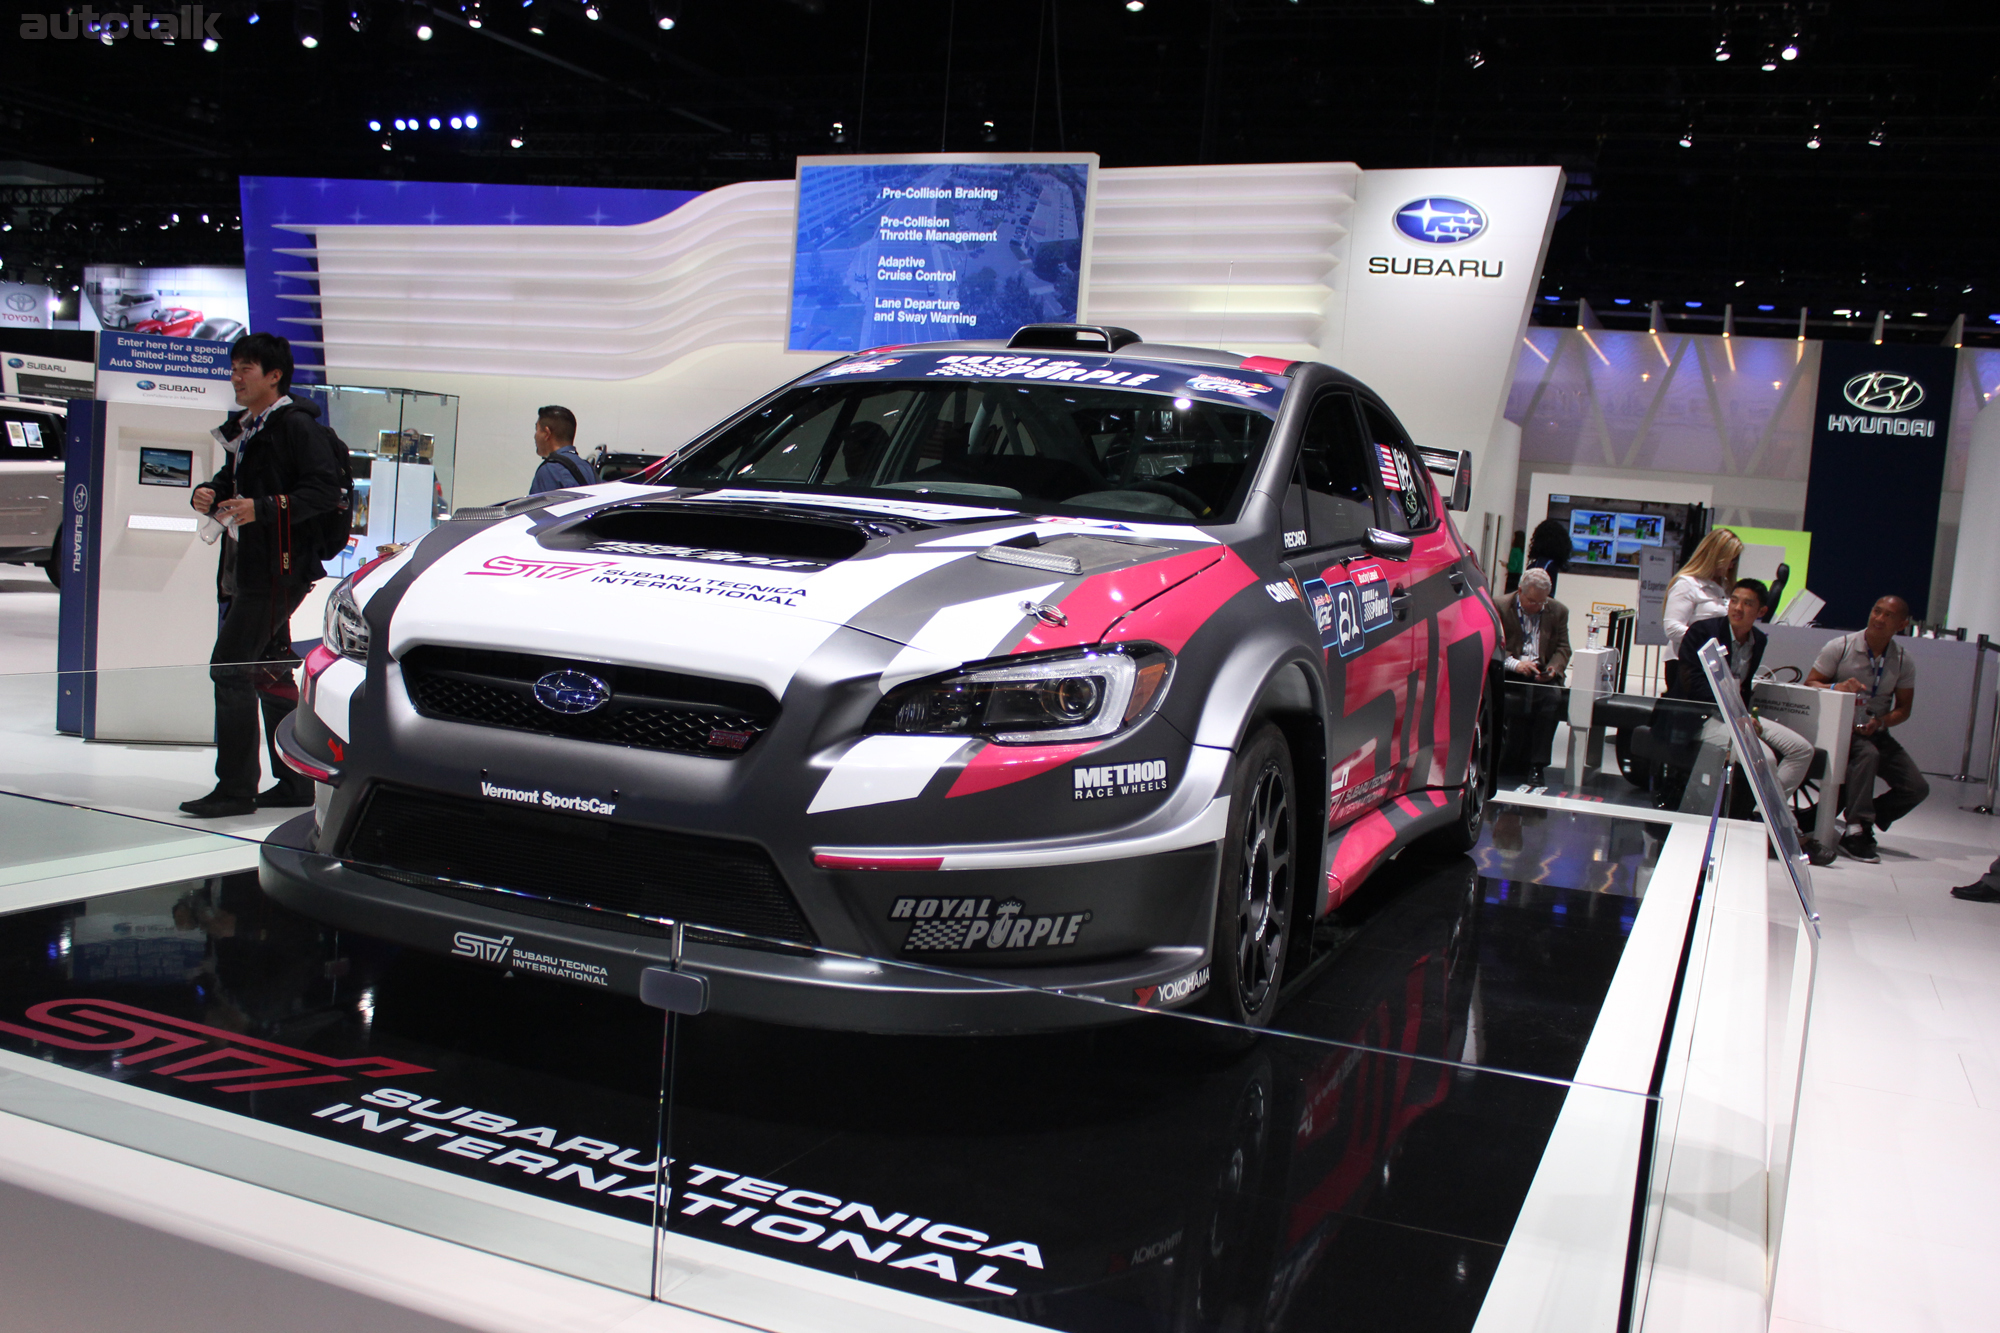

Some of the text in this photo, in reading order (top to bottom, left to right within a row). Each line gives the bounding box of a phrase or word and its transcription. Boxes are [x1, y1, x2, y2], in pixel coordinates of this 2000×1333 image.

[882, 187, 998, 201] Pre-Collision Braking
[880, 215, 950, 228] Pre-Collision
[880, 229, 998, 243] Throttle Management
[877, 255, 925, 269] Adaptive
[1368, 256, 1504, 278] SUBARU
[877, 268, 956, 282] Cruise Control
[874, 297, 960, 311] Lane Departure
[2, 313, 40, 323] TOYOTA
[873, 311, 977, 327] and Sway Warning
[117, 337, 229, 356] Enter here for a special
[130, 348, 214, 365] limited-time $250
[26, 361, 67, 373] SUBARU
[109, 357, 233, 377] Auto Show purchase offer
[936, 355, 1161, 387] ROYAL PURPLE
[158, 383, 206, 394] SUBARU
[1827, 414, 1936, 438] HYUNDAI
[73, 514, 84, 572] SUBARU
[1284, 530, 1307, 549] RECARO
[282, 552, 290, 569] EOS
[591, 575, 798, 607] INTERNATIONAL
[602, 568, 808, 597] SUBARU TECNICA
[1338, 589, 1360, 646] 81
[1782, 701, 1811, 710] TECNICA
[1074, 759, 1167, 789] METHOD
[481, 781, 616, 815] Vermont SportsCar
[1074, 780, 1167, 800] RACE WHEELS
[890, 898, 1085, 950] ROYAL PURPLE
[512, 949, 608, 976] SUBARU TECNICA
[512, 959, 608, 986] INTERNATIONAL
[1157, 966, 1210, 1002] YOKOHAMA
[360, 1087, 1045, 1269] SUBARU TECNICA
[311, 1102, 1020, 1296] INTERNATIONAL
